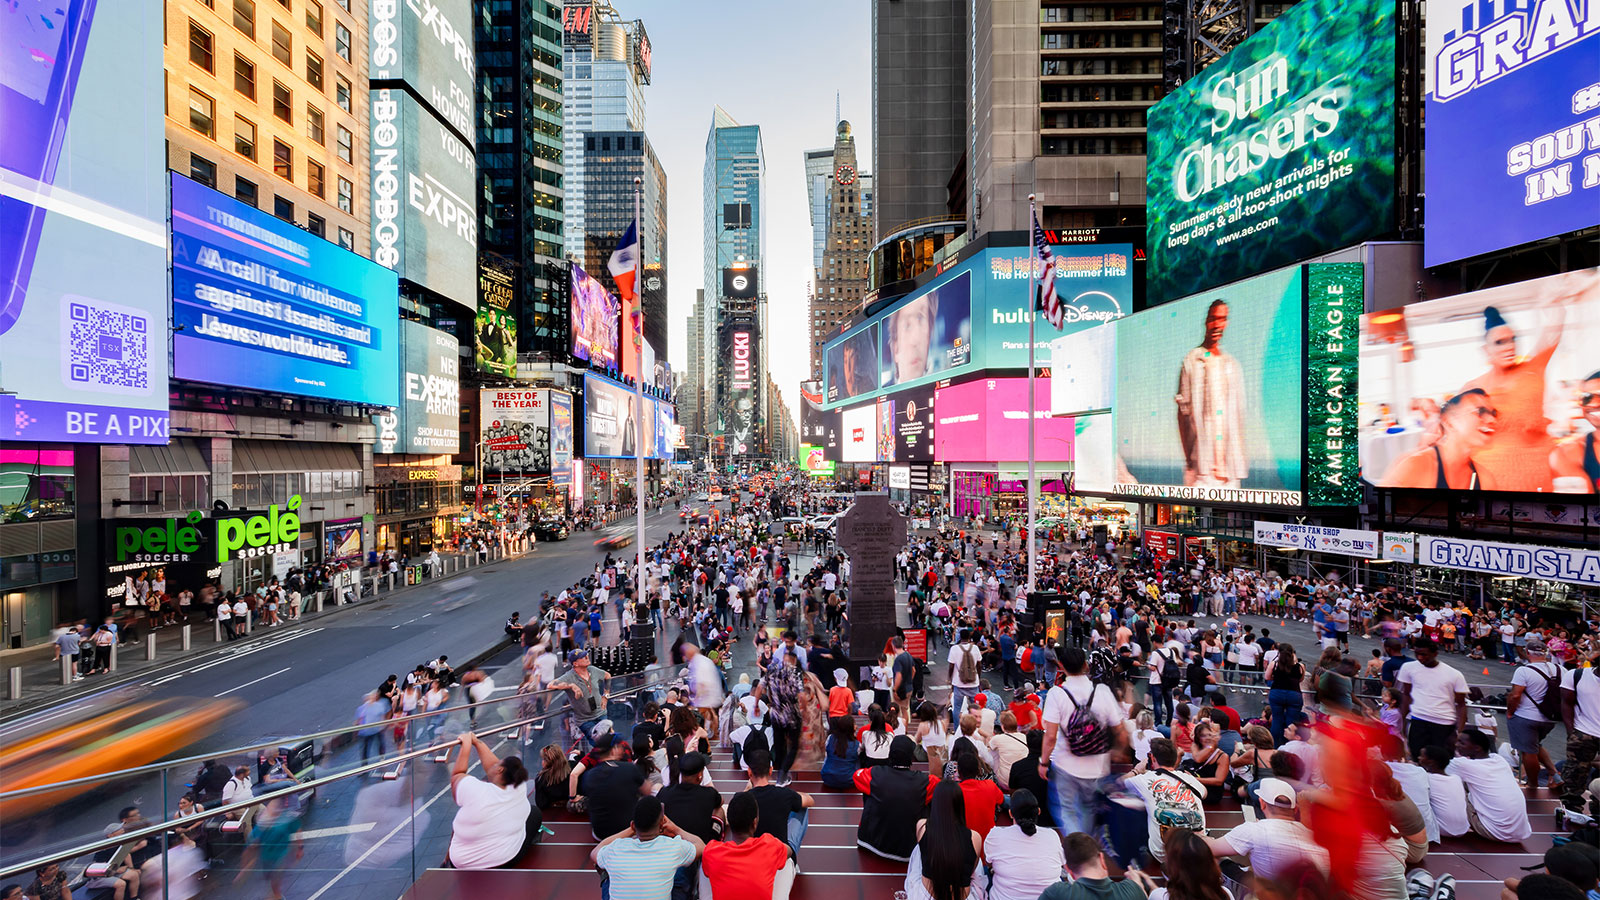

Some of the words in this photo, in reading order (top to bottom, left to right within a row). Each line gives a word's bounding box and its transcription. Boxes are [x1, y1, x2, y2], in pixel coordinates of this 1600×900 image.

[1433, 0, 1600, 103] GRA
[450, 80, 470, 116] FOR
[1211, 57, 1289, 137] Sun
[440, 132, 463, 163] YOU
[1177, 90, 1340, 203] Chasers
[1169, 194, 1244, 236] Summer-ready
[1246, 181, 1273, 200] new
[1275, 159, 1325, 189] arrivals
[1328, 147, 1351, 165] for
[1525, 162, 1572, 206] IN
[1168, 231, 1189, 249] long
[1191, 219, 1215, 240] days
[1217, 214, 1227, 228] &
[1228, 181, 1304, 224] all-too-short
[1306, 163, 1354, 193] nights
[1216, 215, 1279, 247] www.ae.com
[991, 270, 1012, 279] The
[1056, 268, 1102, 278] Summer
[1105, 267, 1126, 277] Hits
[993, 308, 1035, 323] hulu
[1328, 284, 1344, 353] EAGLE
[102, 342, 120, 353] TSX
[734, 332, 749, 380] LUCKI
[492, 400, 511, 408] THE
[513, 400, 541, 408] YEAR!
[497, 392, 523, 400] BEST
[524, 392, 537, 400] OF
[66, 412, 98, 436] BE
[105, 414, 122, 436] A
[1327, 366, 1343, 486] AMERICAN
[409, 471, 438, 480] EXPRESS
[1112, 484, 1165, 497] AMERICAN
[1168, 486, 1206, 500] EAGLE
[1208, 488, 1300, 506] OUTFITTERS
[116, 510, 203, 561] pelé
[217, 494, 302, 563] pelé
[1283, 524, 1306, 533] SPORTS
[1308, 526, 1321, 534] FAN
[1322, 528, 1340, 536] SHOP
[136, 554, 189, 562] SOCCER
[238, 543, 290, 559] SOCCER
[1431, 540, 1531, 575] GRAND
[109, 565, 123, 573] THE
